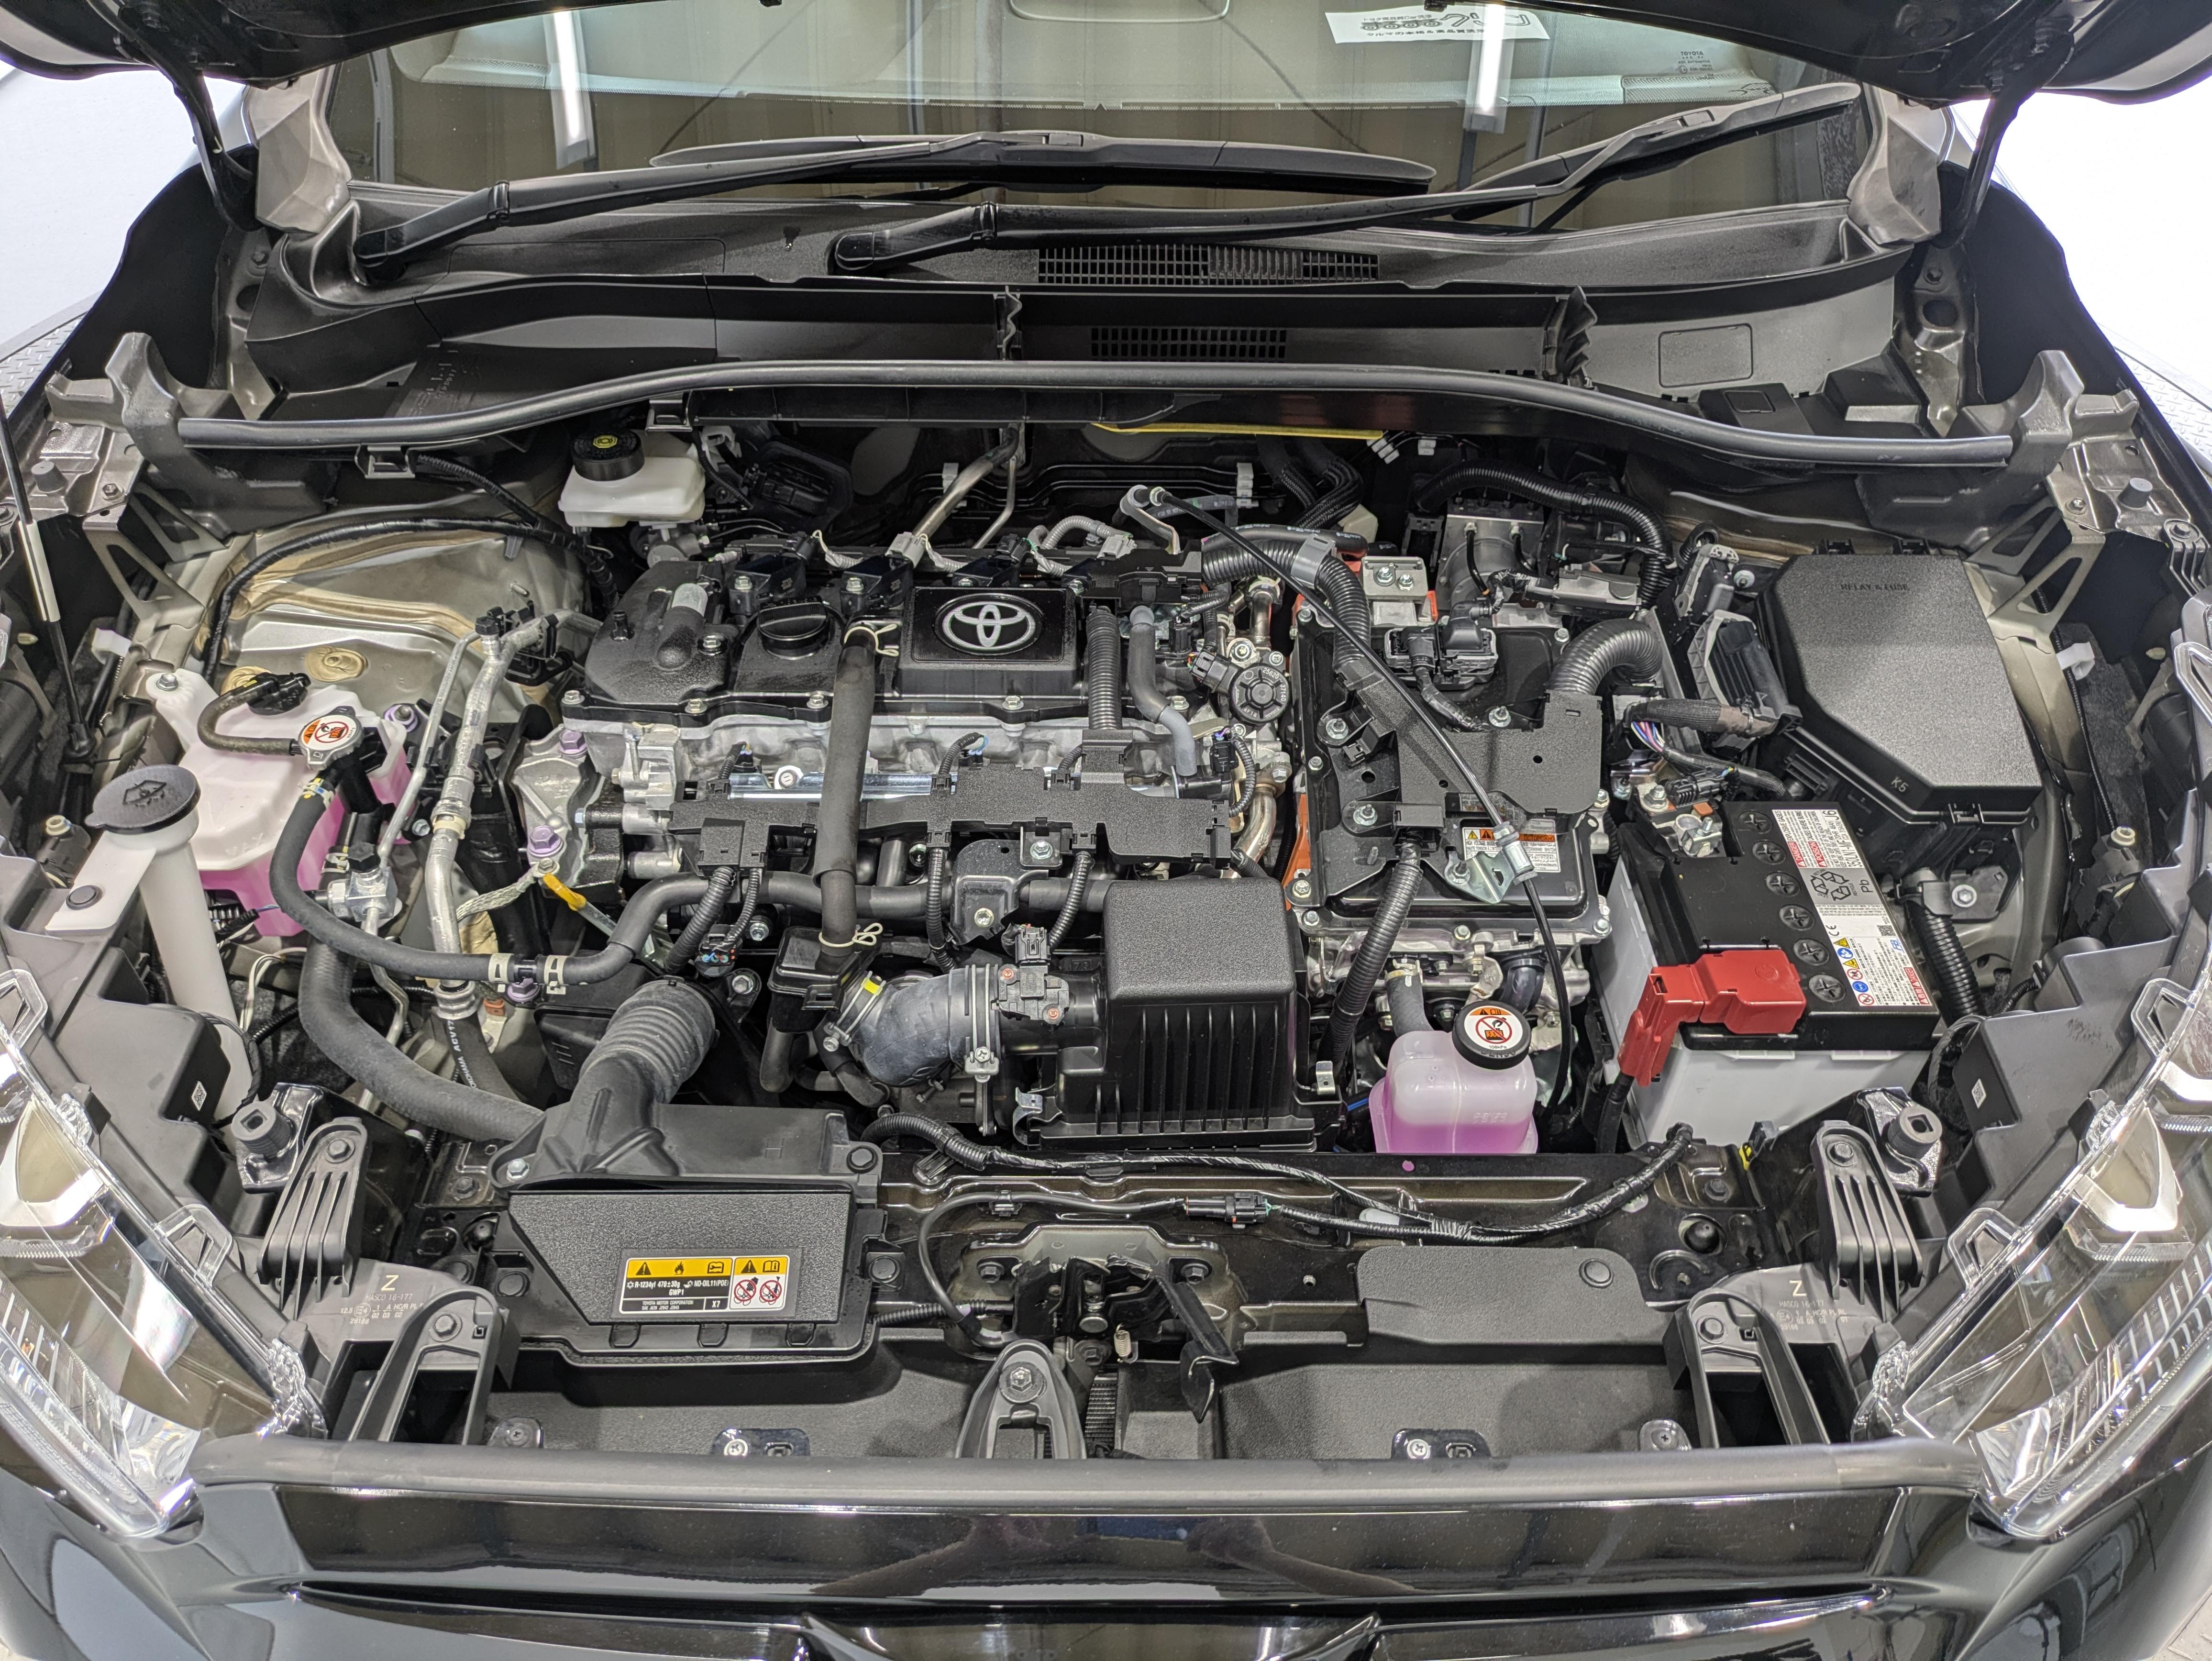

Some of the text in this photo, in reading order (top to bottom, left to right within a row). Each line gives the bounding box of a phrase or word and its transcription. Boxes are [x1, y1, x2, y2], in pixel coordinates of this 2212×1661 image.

[1262, 667, 1279, 679] 25620
[1264, 708, 1281, 719] TOYOTA
[1891, 777, 1909, 792] K5
[1774, 810, 1785, 822] GASES
[1822, 810, 1840, 820] J6
[1780, 823, 1794, 840] EXPLOSIVE
[1794, 810, 1824, 860] POISON CAUSES SEVERE BURNS
[1788, 842, 1803, 860] DANGER
[1836, 840, 1862, 866] 350LN1-MF
[1848, 883, 1858, 896] RECYCLE
[1857, 879, 1873, 892] Pb
[1904, 968, 1918, 981] DANGER
[457, 1056, 477, 1089] OKOHAMA
[381, 1274, 399, 1291] Z
[657, 1280, 680, 1288] 470±30g
[694, 1279, 729, 1287] ND-OIL11(POE)
[1789, 1280, 1807, 1296] Z
